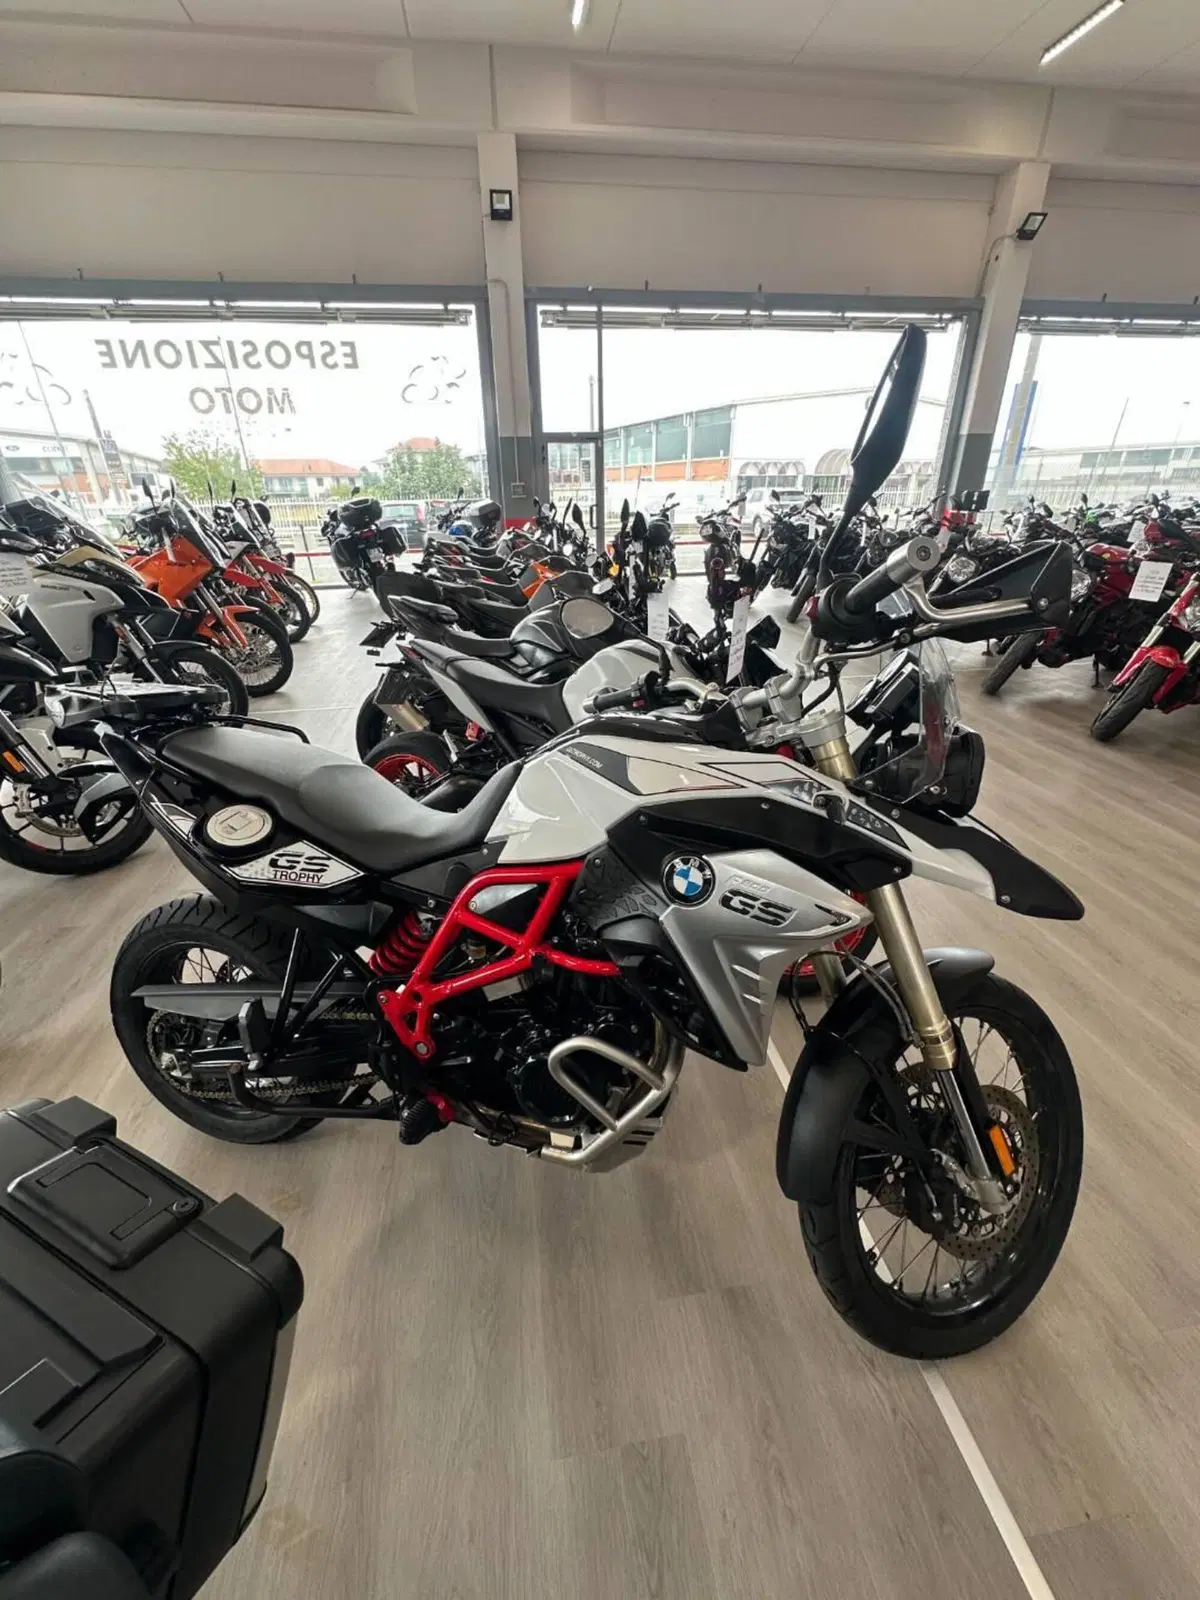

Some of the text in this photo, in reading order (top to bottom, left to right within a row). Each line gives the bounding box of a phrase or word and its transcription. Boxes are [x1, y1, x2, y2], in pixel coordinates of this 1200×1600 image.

[268, 853, 331, 873] GS
[272, 870, 323, 884] TROPHY
[721, 888, 794, 928] GS
